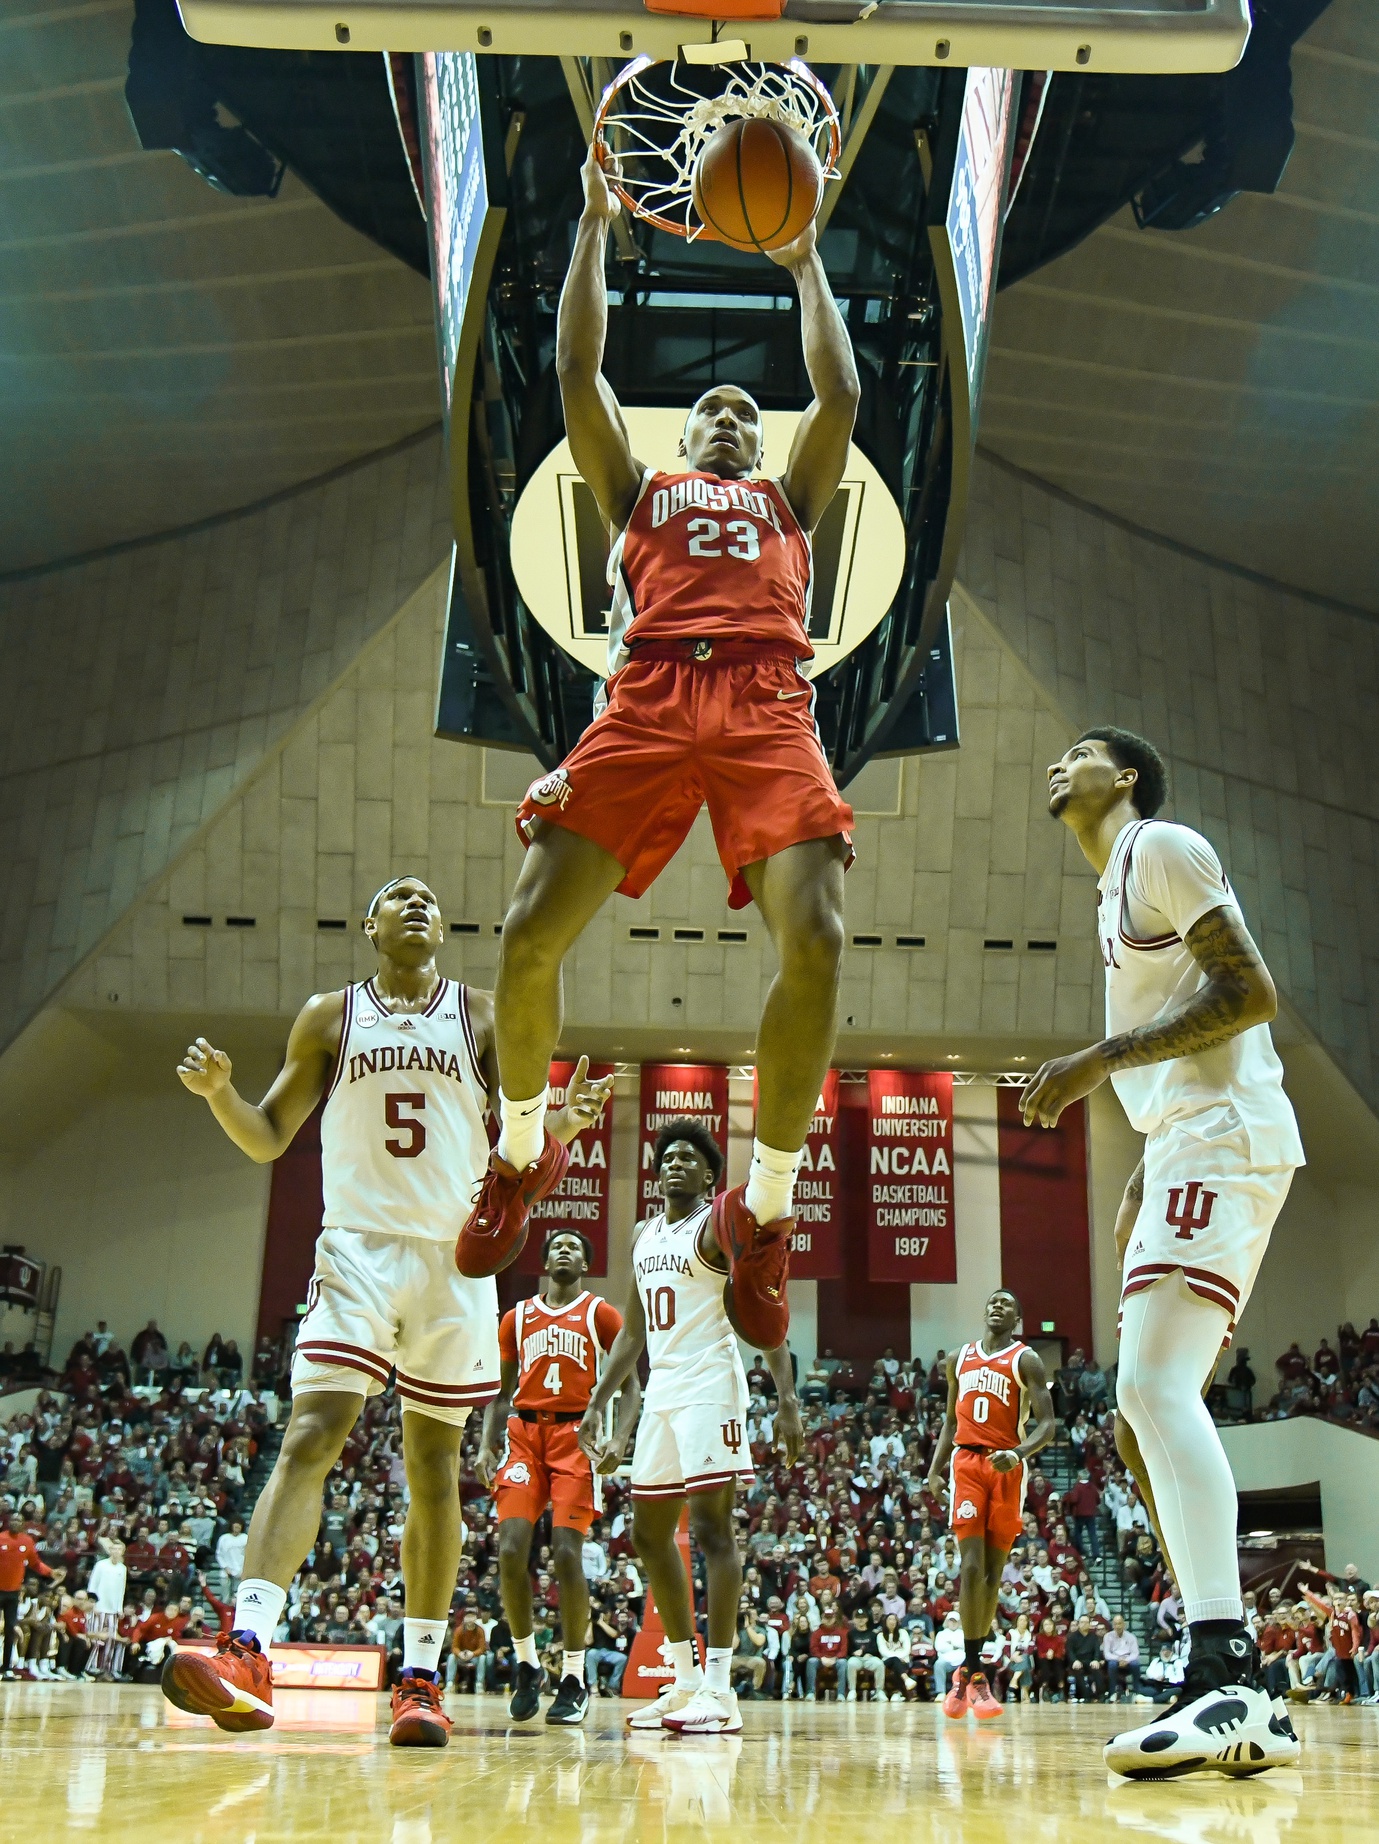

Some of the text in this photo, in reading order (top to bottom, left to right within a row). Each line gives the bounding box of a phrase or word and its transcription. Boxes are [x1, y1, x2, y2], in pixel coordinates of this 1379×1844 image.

[687, 517, 761, 562] 23
[350, 1046, 462, 1084] INDIANA
[655, 1090, 713, 1110] INDIANA
[881, 1095, 939, 1115] INDIANA
[385, 1093, 426, 1158] 5
[873, 1118, 948, 1138] UNIVERSITY
[870, 1146, 951, 1175] NCAA
[872, 1185, 949, 1204] BASKETBALL
[530, 1200, 600, 1220] CHAMPIONS
[876, 1208, 947, 1227] CHAMPIONS
[895, 1237, 929, 1256] 1987
[646, 1286, 676, 1332] 10
[543, 1363, 562, 1395] 4
[973, 1396, 989, 1423] 0
